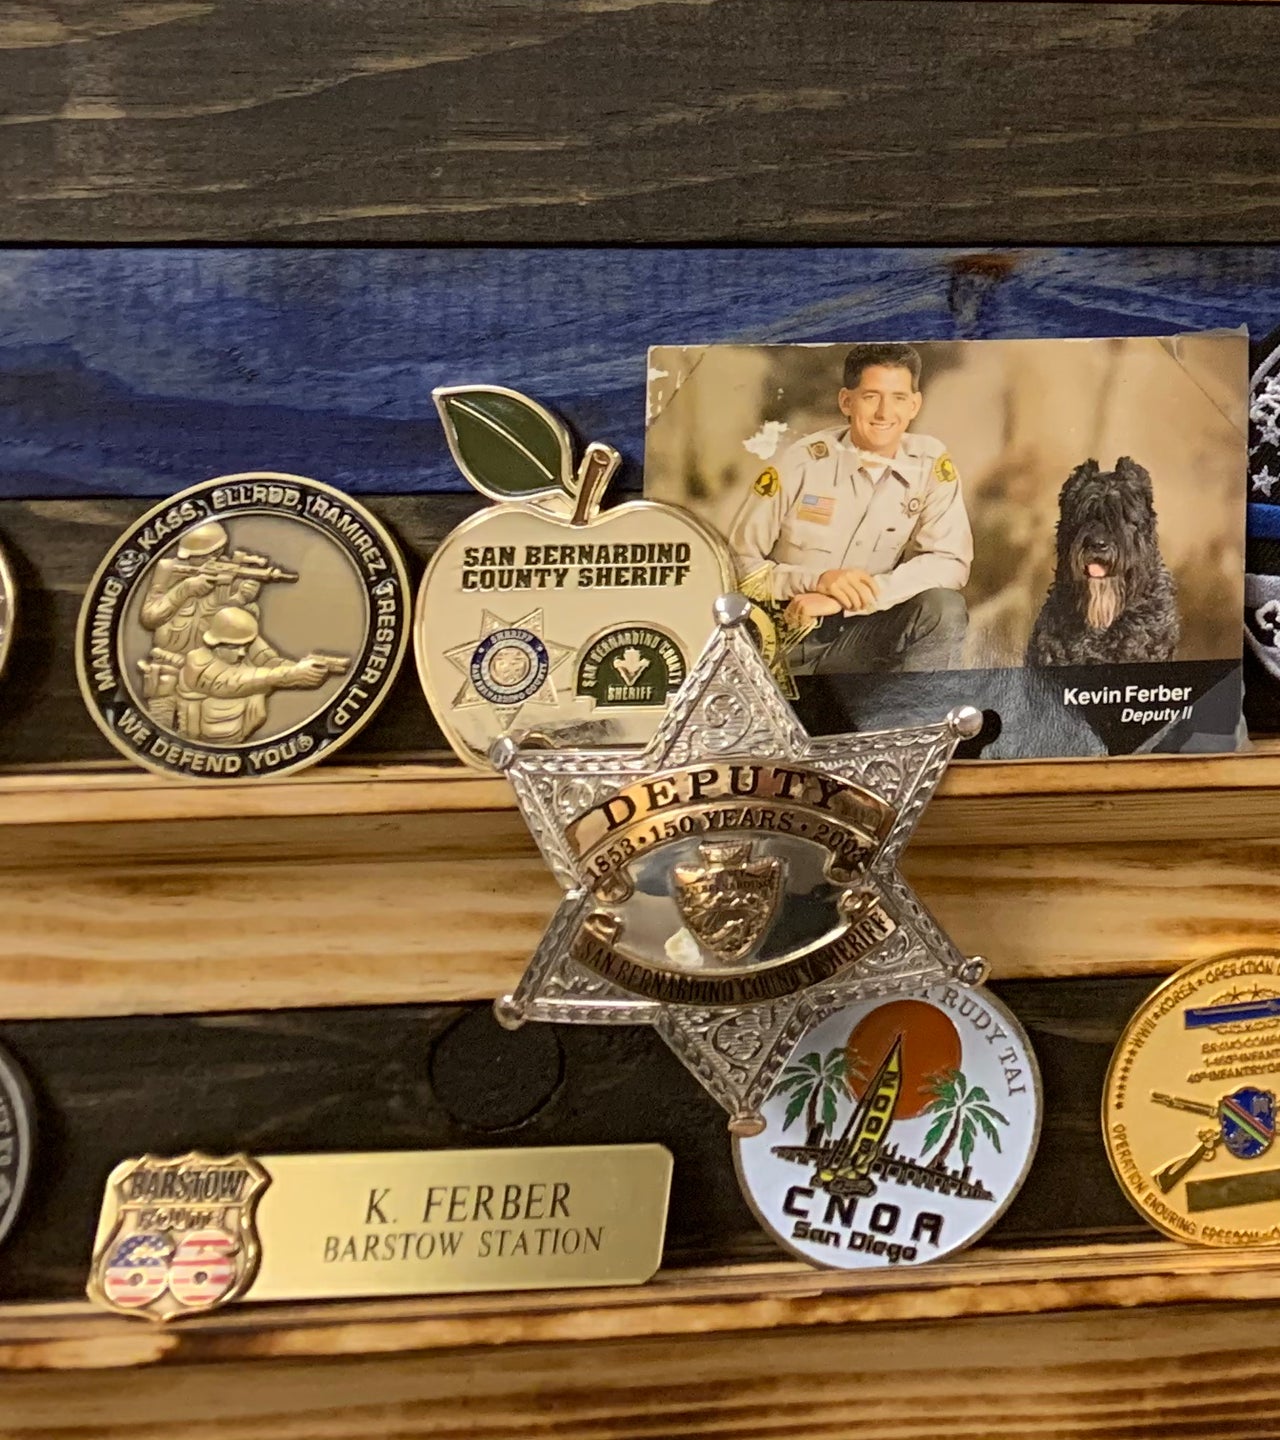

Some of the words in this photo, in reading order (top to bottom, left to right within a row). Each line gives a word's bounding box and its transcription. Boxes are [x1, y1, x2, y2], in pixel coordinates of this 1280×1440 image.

[464, 545, 516, 568] SAN
[525, 543, 692, 567] BERNARDINO
[462, 568, 567, 592] COUNTY
[577, 565, 692, 588] SHERIFF
[608, 685, 653, 701] SHERIFF
[1063, 687, 1121, 706] Kevin
[1125, 684, 1193, 704] Ferber
[1121, 708, 1180, 725] Deputy
[600, 765, 848, 833] DEPUTY
[940, 986, 1009, 1045] RUDY
[998, 1046, 1027, 1097] TAI
[128, 1167, 248, 1203] BARSTOW
[365, 1187, 398, 1225] K.
[422, 1182, 573, 1223] FERBER
[782, 1186, 944, 1247] CNOA
[323, 1230, 463, 1263] BARSTOW
[478, 1226, 605, 1257] STATION
[791, 1221, 841, 1247] San
[847, 1231, 919, 1263] Diego
